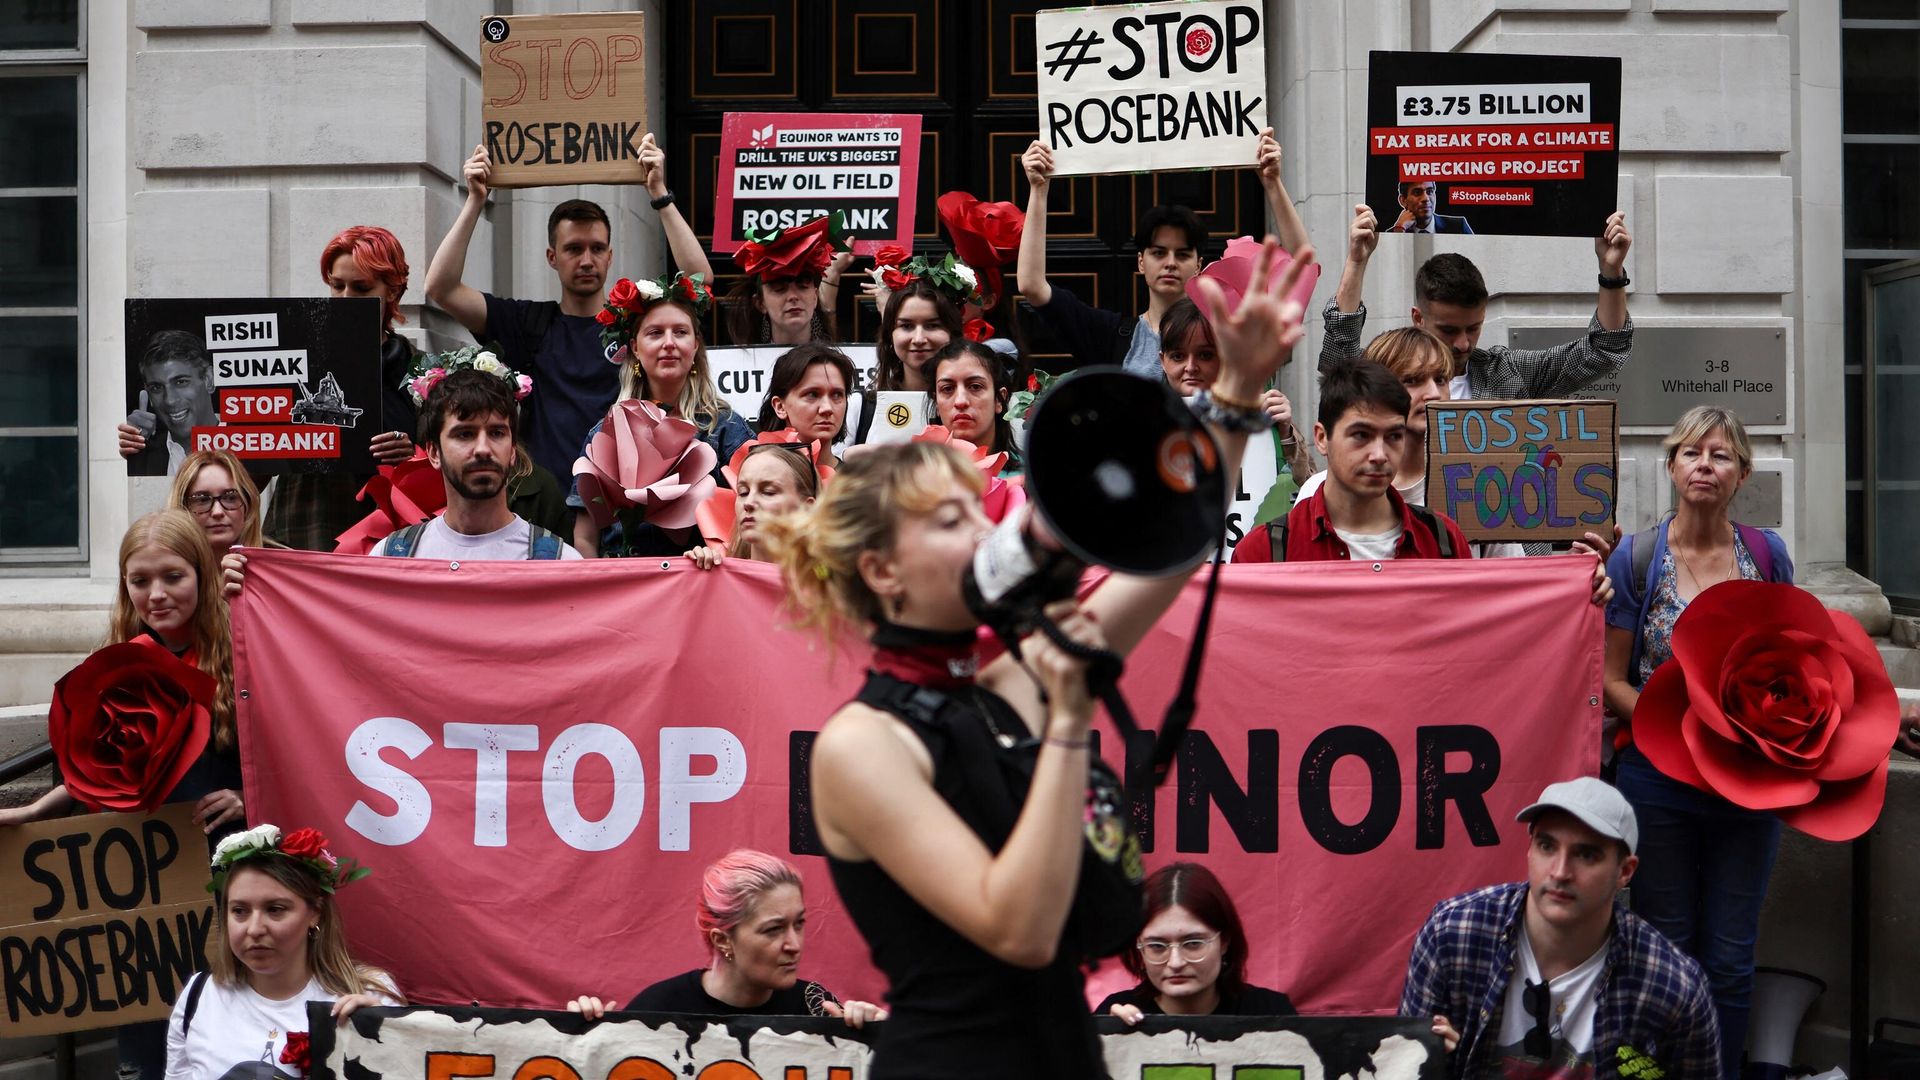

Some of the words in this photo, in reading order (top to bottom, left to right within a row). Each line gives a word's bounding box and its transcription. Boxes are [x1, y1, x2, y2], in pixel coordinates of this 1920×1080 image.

[1044, 5, 1260, 82] #STOP
[489, 34, 643, 108] STOP
[1402, 96, 1471, 116] £3.75
[1479, 93, 1584, 115] BILLION
[1047, 90, 1263, 151] ROSEBANK
[486, 120, 641, 166] ROSEBANK
[779, 132, 833, 143] EQUINOR
[837, 132, 880, 142] WANTS
[883, 131, 899, 142] TO
[1374, 134, 1410, 148] TAX
[1415, 133, 1472, 148] BREAK
[1477, 132, 1512, 147] FOR
[1516, 132, 1529, 146] A
[1533, 131, 1610, 146] CLIMATE
[738, 151, 777, 163] DRILL
[780, 151, 805, 163] THE
[808, 151, 838, 162] UK'S
[841, 150, 897, 162] BIGGEST
[1403, 161, 1496, 176] WRECKING
[1501, 159, 1580, 175] PROJECT
[739, 174, 787, 190] NEW
[793, 173, 826, 190] OIL
[833, 173, 893, 189] FIELD
[1451, 190, 1531, 203] #StopRosebank
[211, 321, 273, 342] RISHI
[218, 357, 304, 378] SUNAK
[1704, 360, 1729, 373] 3-8
[717, 370, 764, 394] CUT
[1662, 379, 1728, 393] Whitehall
[1733, 379, 1773, 393] Place
[225, 396, 288, 416] STOP
[1436, 406, 1599, 454] FOSSIL
[196, 431, 335, 452] ROSEBANK!
[1442, 462, 1614, 529] FOOLS
[345, 716, 748, 852] STOP
[788, 724, 1500, 855] INOR
[23, 819, 179, 921] STOP
[0, 905, 213, 1023] ROSEBANK
